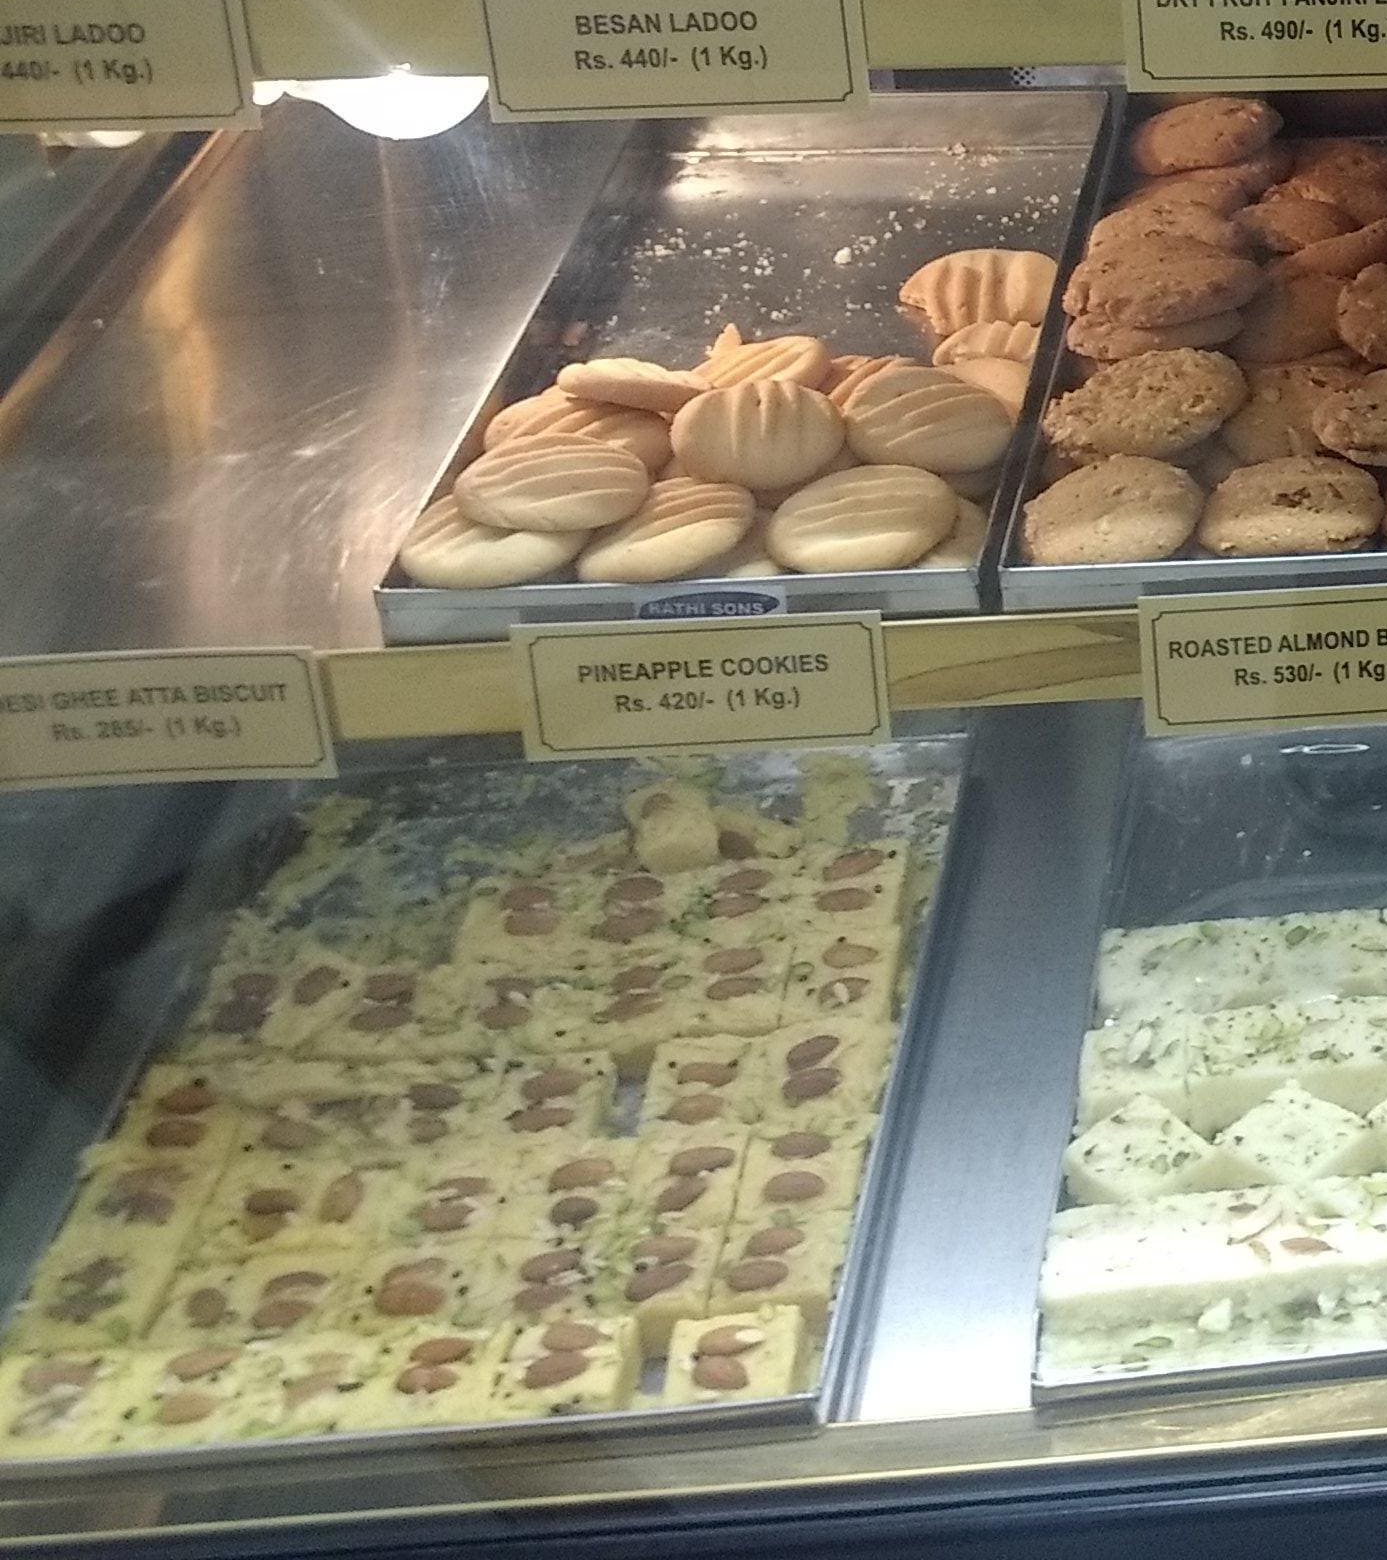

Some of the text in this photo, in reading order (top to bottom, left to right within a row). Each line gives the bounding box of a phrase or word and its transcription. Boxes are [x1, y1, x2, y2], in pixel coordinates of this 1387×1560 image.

[54, 23, 145, 45] LADOO
[575, 11, 757, 35] BESAN LADOO
[1220, 22, 1254, 41] Rs.
[1261, 20, 1313, 41] 490/-
[1325, 20, 1341, 43] (1
[575, 45, 768, 71] Rs. 440/- (1 Kg.)
[74, 60, 93, 85] (1
[103, 59, 153, 84] Kg.)
[711, 602, 764, 615] SONS
[1169, 636, 1272, 659] ROASTED
[1278, 629, 1370, 654] ALMOND
[578, 653, 828, 683] PINEAPPLE COOKIES
[1235, 668, 1267, 686] Rs.
[1274, 664, 1322, 684] 530/-
[1334, 661, 1351, 683] (1
[52, 688, 121, 710] GHEE
[129, 687, 187, 705] ATTA
[193, 683, 286, 704] BISCUIT
[616, 687, 800, 712] Rs. 420/- (1 Kg.)
